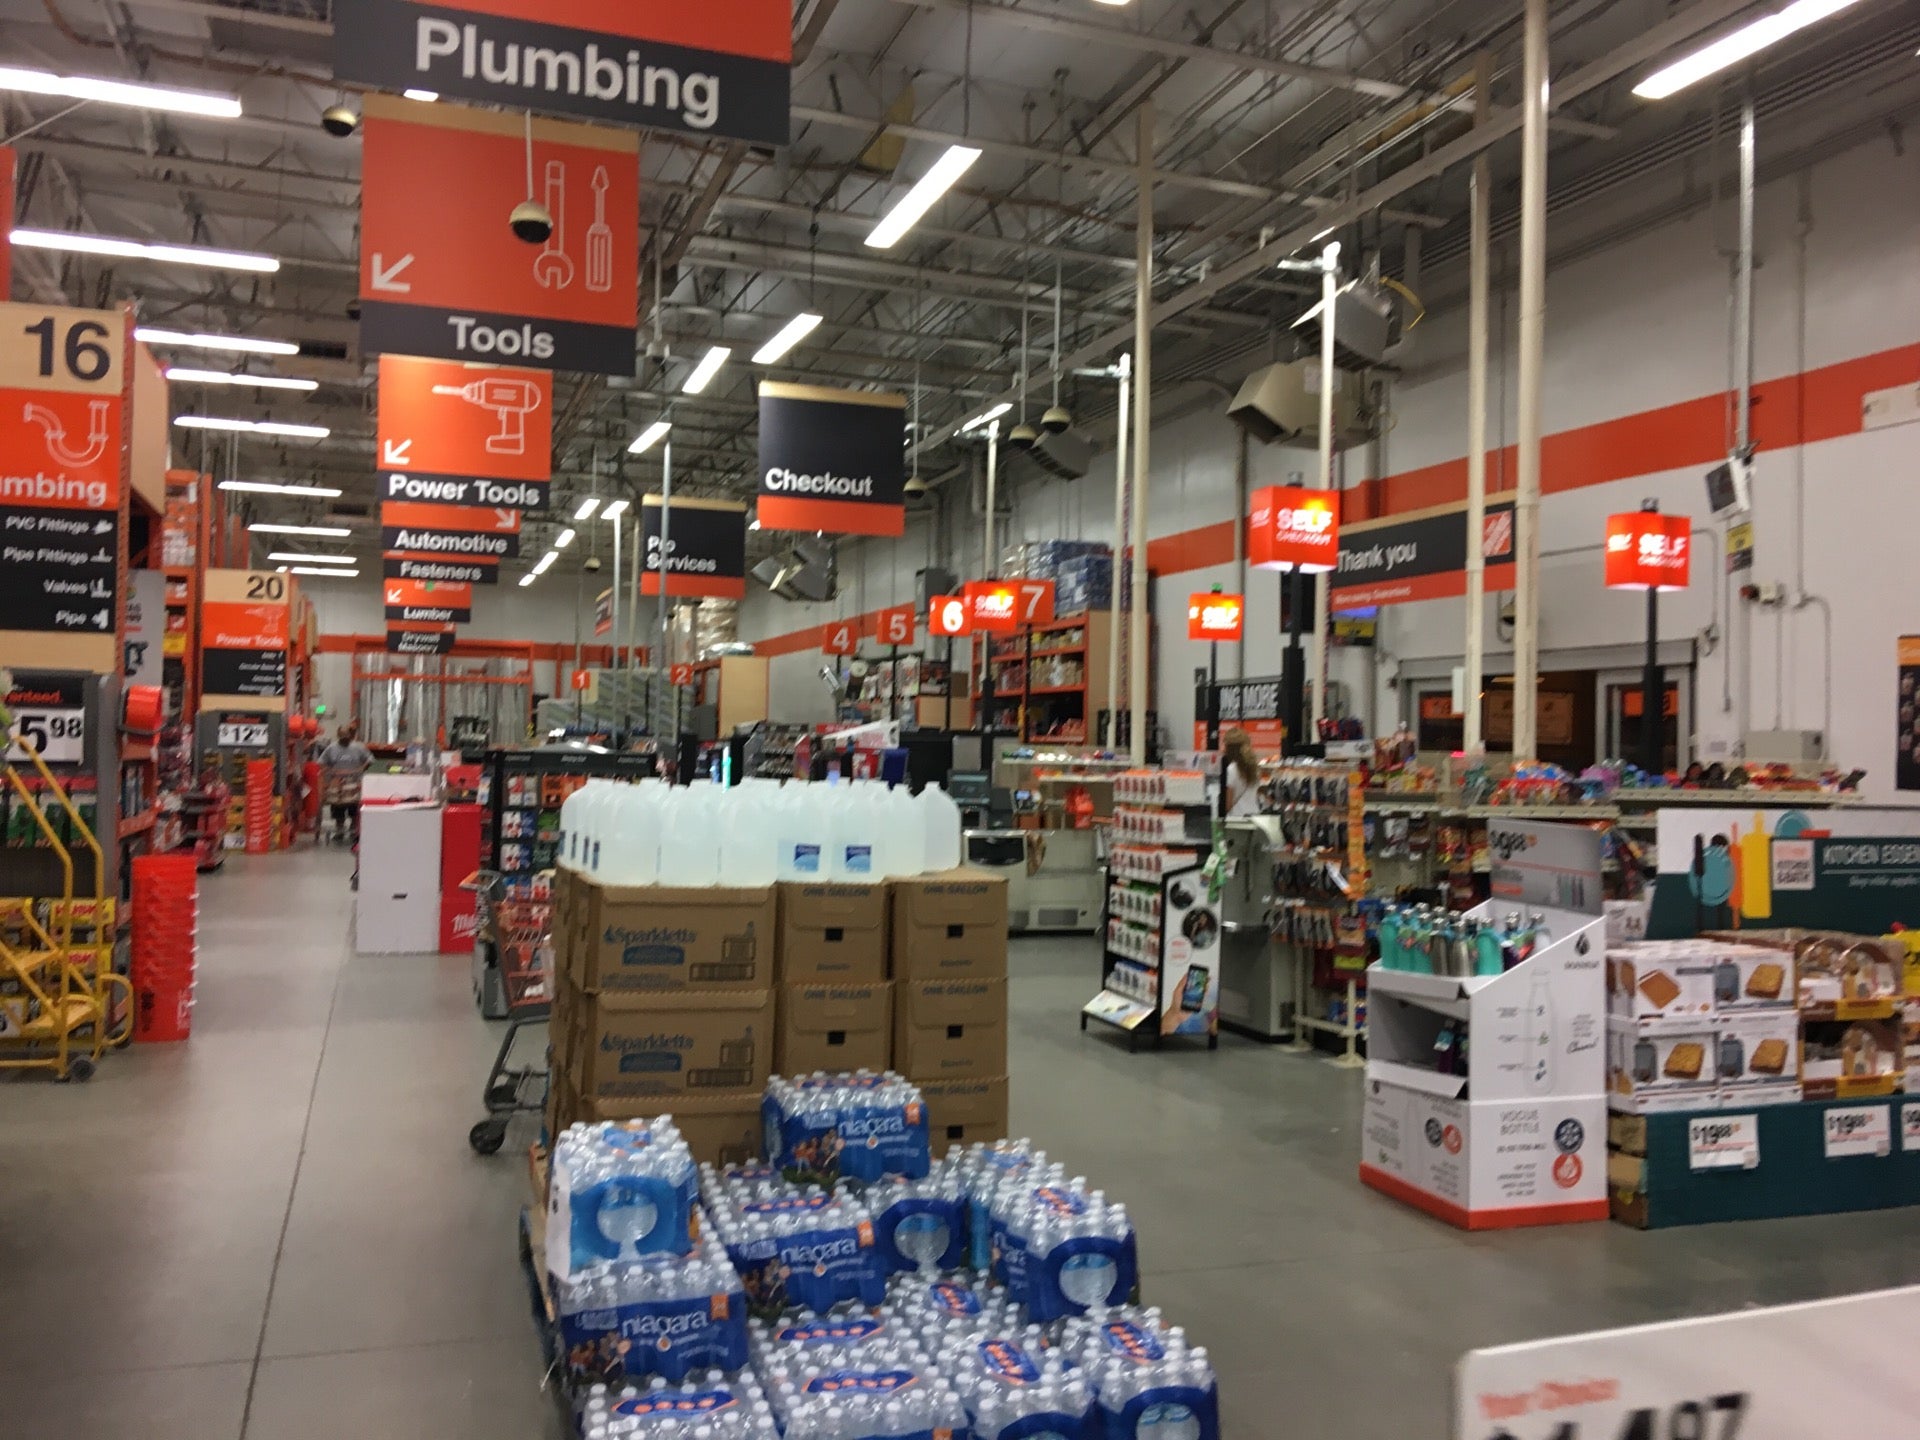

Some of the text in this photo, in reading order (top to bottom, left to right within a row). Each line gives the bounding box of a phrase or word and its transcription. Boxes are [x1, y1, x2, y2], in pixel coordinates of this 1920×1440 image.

[416, 17, 720, 129] Plumbing
[25, 316, 111, 382] 16
[448, 316, 555, 359] Tools
[0, 471, 107, 508] mbing
[389, 473, 541, 507] Power Tools
[764, 466, 874, 497] Checkout
[5, 515, 36, 530] PVC
[1277, 508, 1333, 533] SELF
[394, 529, 509, 555] Automotive
[1337, 541, 1417, 573] Thank you
[400, 561, 483, 581] Fasteners
[43, 578, 88, 594] Valves
[246, 574, 284, 601] 20
[1020, 584, 1046, 620] 7
[889, 613, 907, 641] 5
[942, 600, 964, 633] 6
[215, 632, 251, 646] Power
[832, 626, 850, 651] 4
[576, 672, 586, 688] 1
[675, 666, 690, 684] 2
[837, 1115, 905, 1138] niagara
[781, 1238, 858, 1264] niagara
[621, 1310, 709, 1337] niagara
